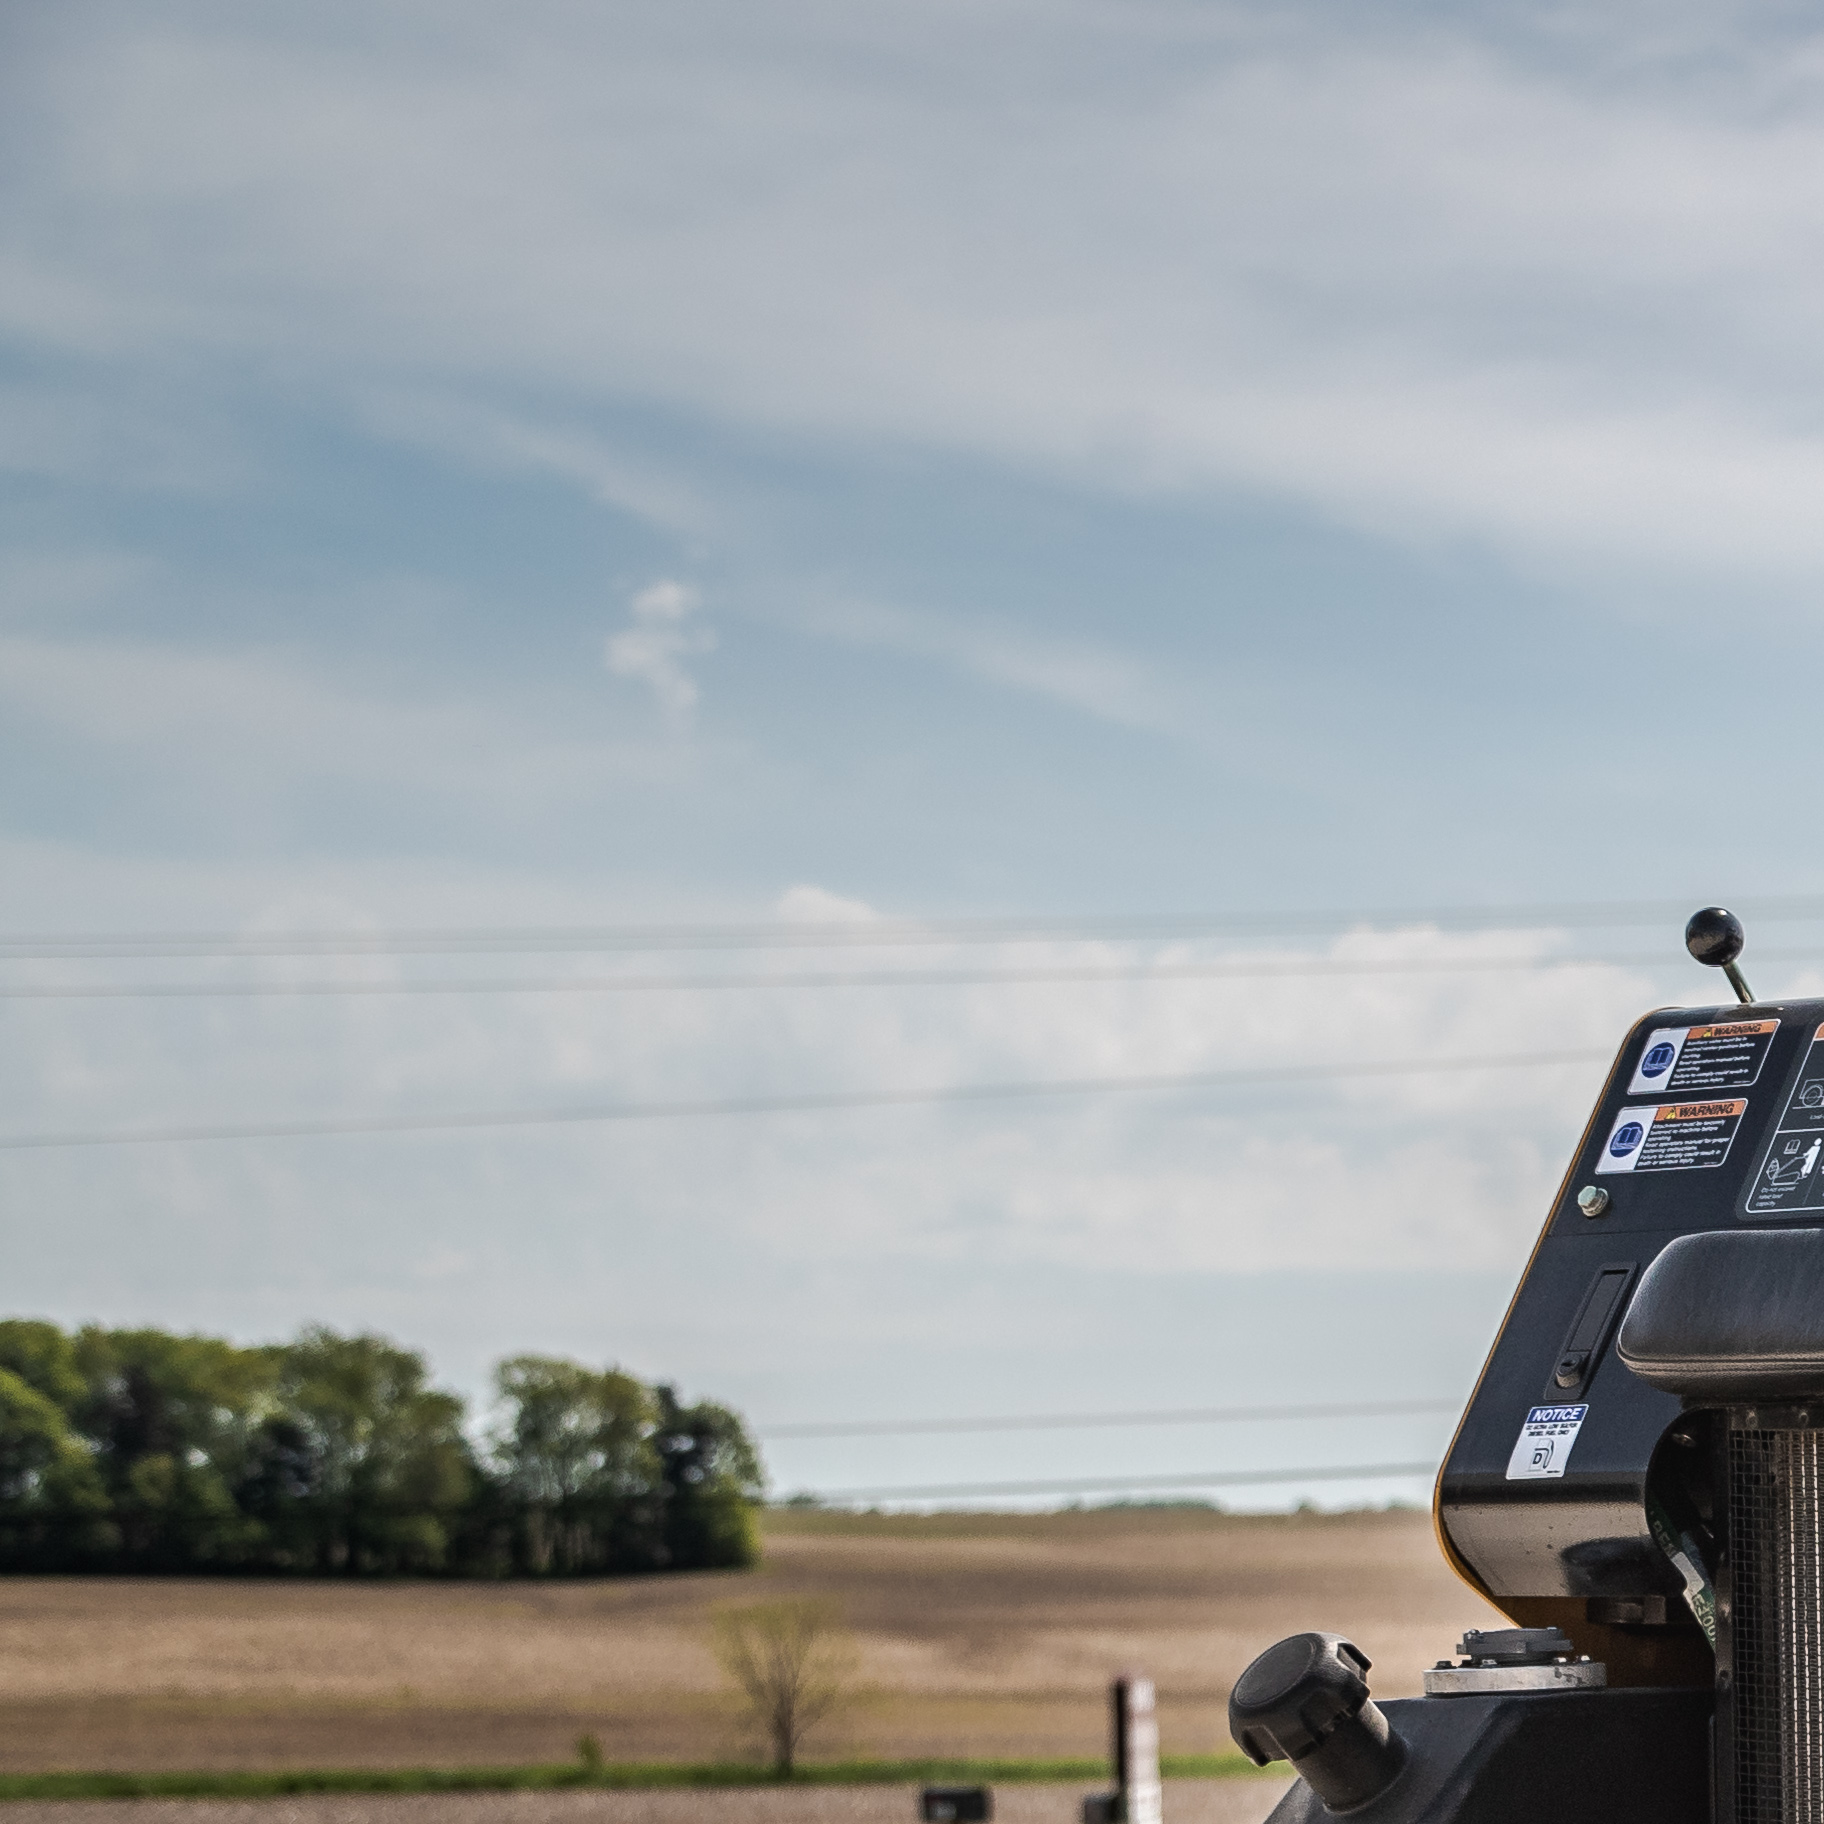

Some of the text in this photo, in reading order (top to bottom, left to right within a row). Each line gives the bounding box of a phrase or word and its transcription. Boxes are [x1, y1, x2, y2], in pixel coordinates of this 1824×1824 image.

[1714, 1024, 1762, 1036] WARNING
[1680, 1103, 1735, 1117] WARNING
[1532, 1407, 1582, 1422] NOTICE
[1532, 1453, 1543, 1465] D
